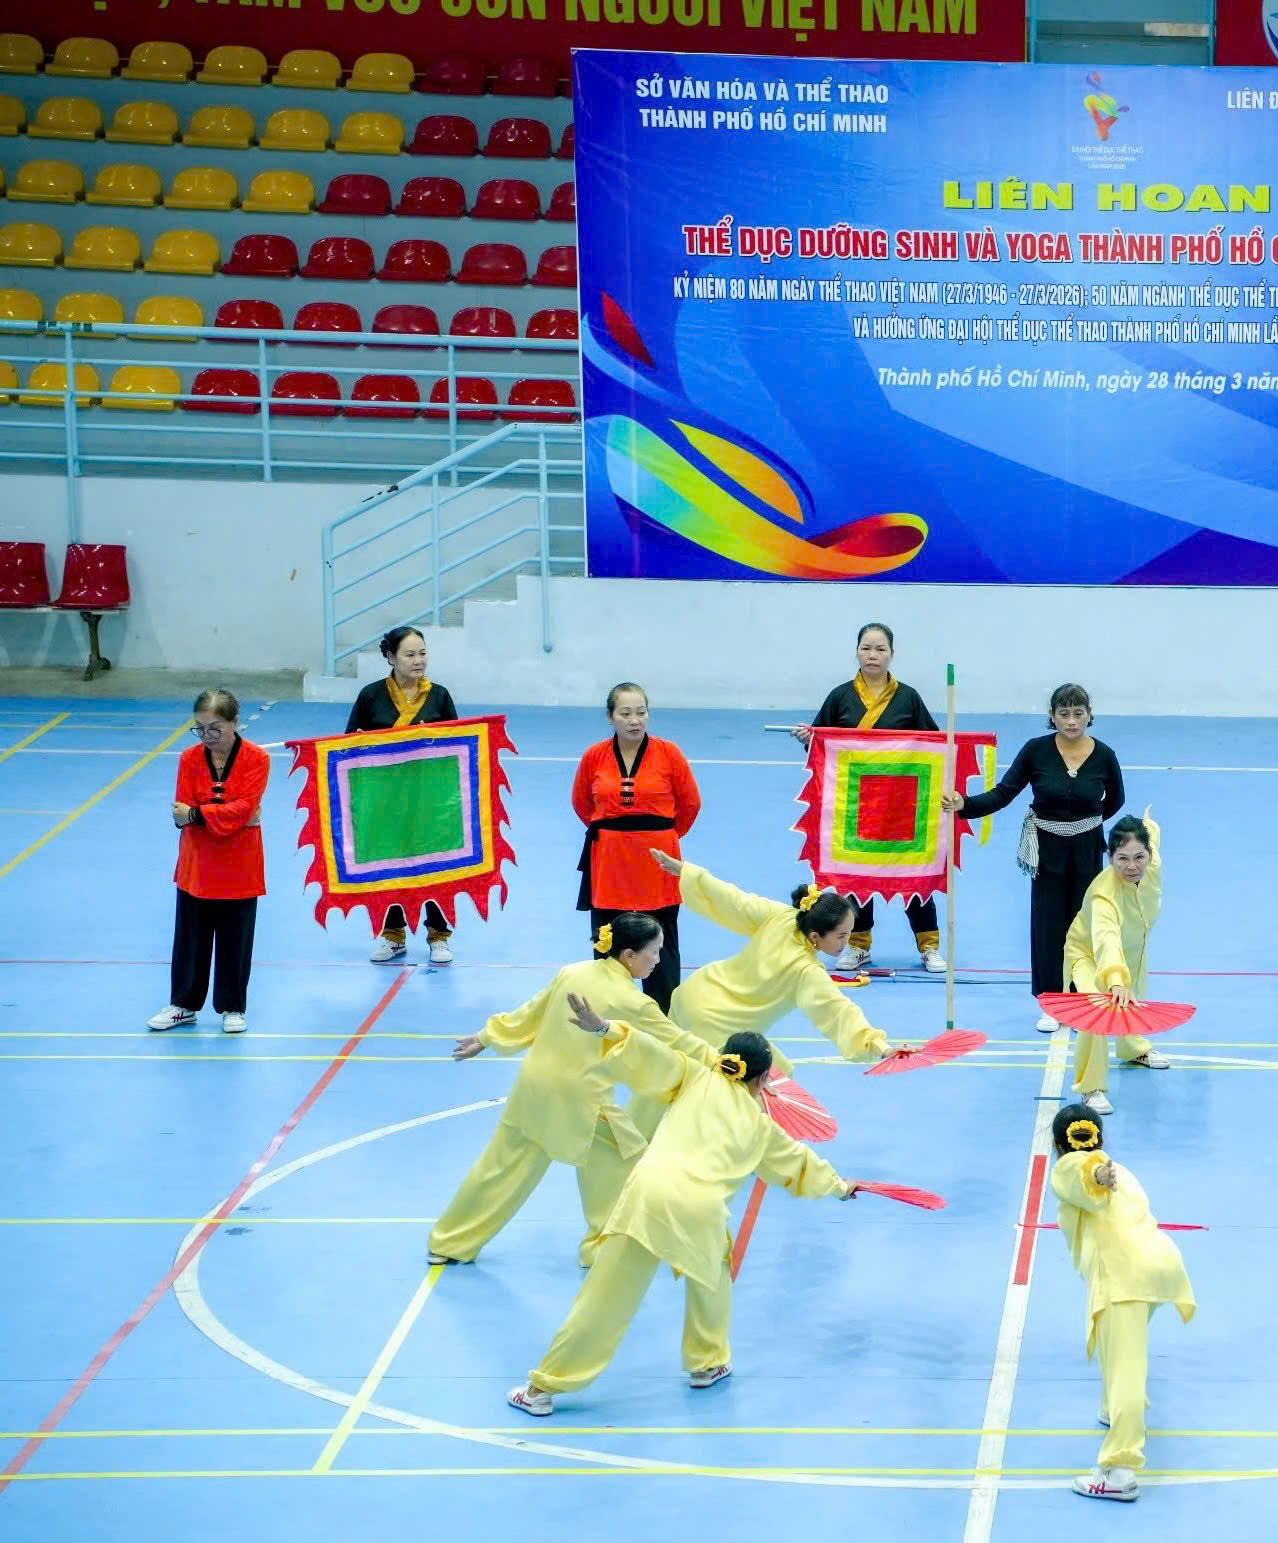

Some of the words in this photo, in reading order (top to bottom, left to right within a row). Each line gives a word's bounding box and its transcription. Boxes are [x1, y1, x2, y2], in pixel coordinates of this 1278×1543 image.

[861, 0, 976, 34] NAM
[636, 73, 663, 98] SỞ
[669, 76, 710, 99] VĂN
[717, 78, 757, 100] HÓA
[763, 79, 789, 101] VÀ
[795, 76, 833, 102] THỂ
[838, 84, 889, 104] THAO
[1227, 87, 1264, 110] LIÊN
[639, 106, 706, 129] THÀNH
[713, 106, 753, 130] PHỐ
[760, 106, 786, 131] HỒ
[793, 110, 826, 132] CHÍ
[833, 114, 887, 133] MINH
[944, 176, 1074, 210] LIÊN
[1097, 183, 1271, 213] HOAN
[682, 214, 733, 256] THỂ
[739, 226, 792, 263] DỤC
[799, 222, 888, 260] DƯỠNG
[895, 230, 958, 261] SINH
[965, 226, 1000, 262] VÀ
[1005, 231, 1072, 263] YOGA
[1079, 227, 1164, 264] THÀNH
[1171, 224, 1225, 265] PHỐ
[1229, 225, 1264, 265] HỒ
[673, 271, 690, 298] KỶ
[693, 274, 727, 303] NIỆM
[730, 279, 745, 300] 80
[749, 274, 778, 301] NĂM
[781, 275, 815, 302] NGÀY
[818, 272, 842, 302] THỂ
[844, 281, 876, 302] THAO
[880, 276, 906, 307] VIỆT
[909, 282, 938, 304] NAM
[942, 282, 1007, 305] (27/3/1946
[1019, 283, 1088, 309] 27/3/2026);
[1091, 285, 1107, 306] 50
[1110, 280, 1139, 306] NĂM
[1142, 280, 1185, 307] NGÀNH
[1189, 277, 1212, 307] THỂ
[1215, 287, 1240, 312] DỤC
[1243, 278, 1267, 308] THỂ
[853, 312, 870, 337] VÀ
[873, 311, 915, 339] HƯỞNG
[919, 313, 945, 340] ỨNG
[948, 319, 969, 345] ĐẠI
[972, 315, 993, 345] HỘI
[996, 311, 1020, 341] THỂ
[1022, 320, 1047, 346] DỤC
[1050, 312, 1074, 341] THỂ
[1077, 321, 1107, 342] THAO
[1111, 316, 1151, 343] THÀNH
[1155, 314, 1180, 343] PHỐ
[1183, 314, 1199, 343] HỒ
[1203, 318, 1224, 343] CHÍ
[1227, 322, 1259, 344] MINH
[878, 367, 930, 386] Thành
[936, 366, 974, 390] phố
[977, 364, 1002, 387] Hồ
[1007, 369, 1039, 387] Chí
[1042, 370, 1090, 390] Minh,
[1096, 371, 1142, 394] ngày
[1147, 372, 1168, 389] 28
[1174, 371, 1226, 394] tháng
[1231, 373, 1241, 390] 3
